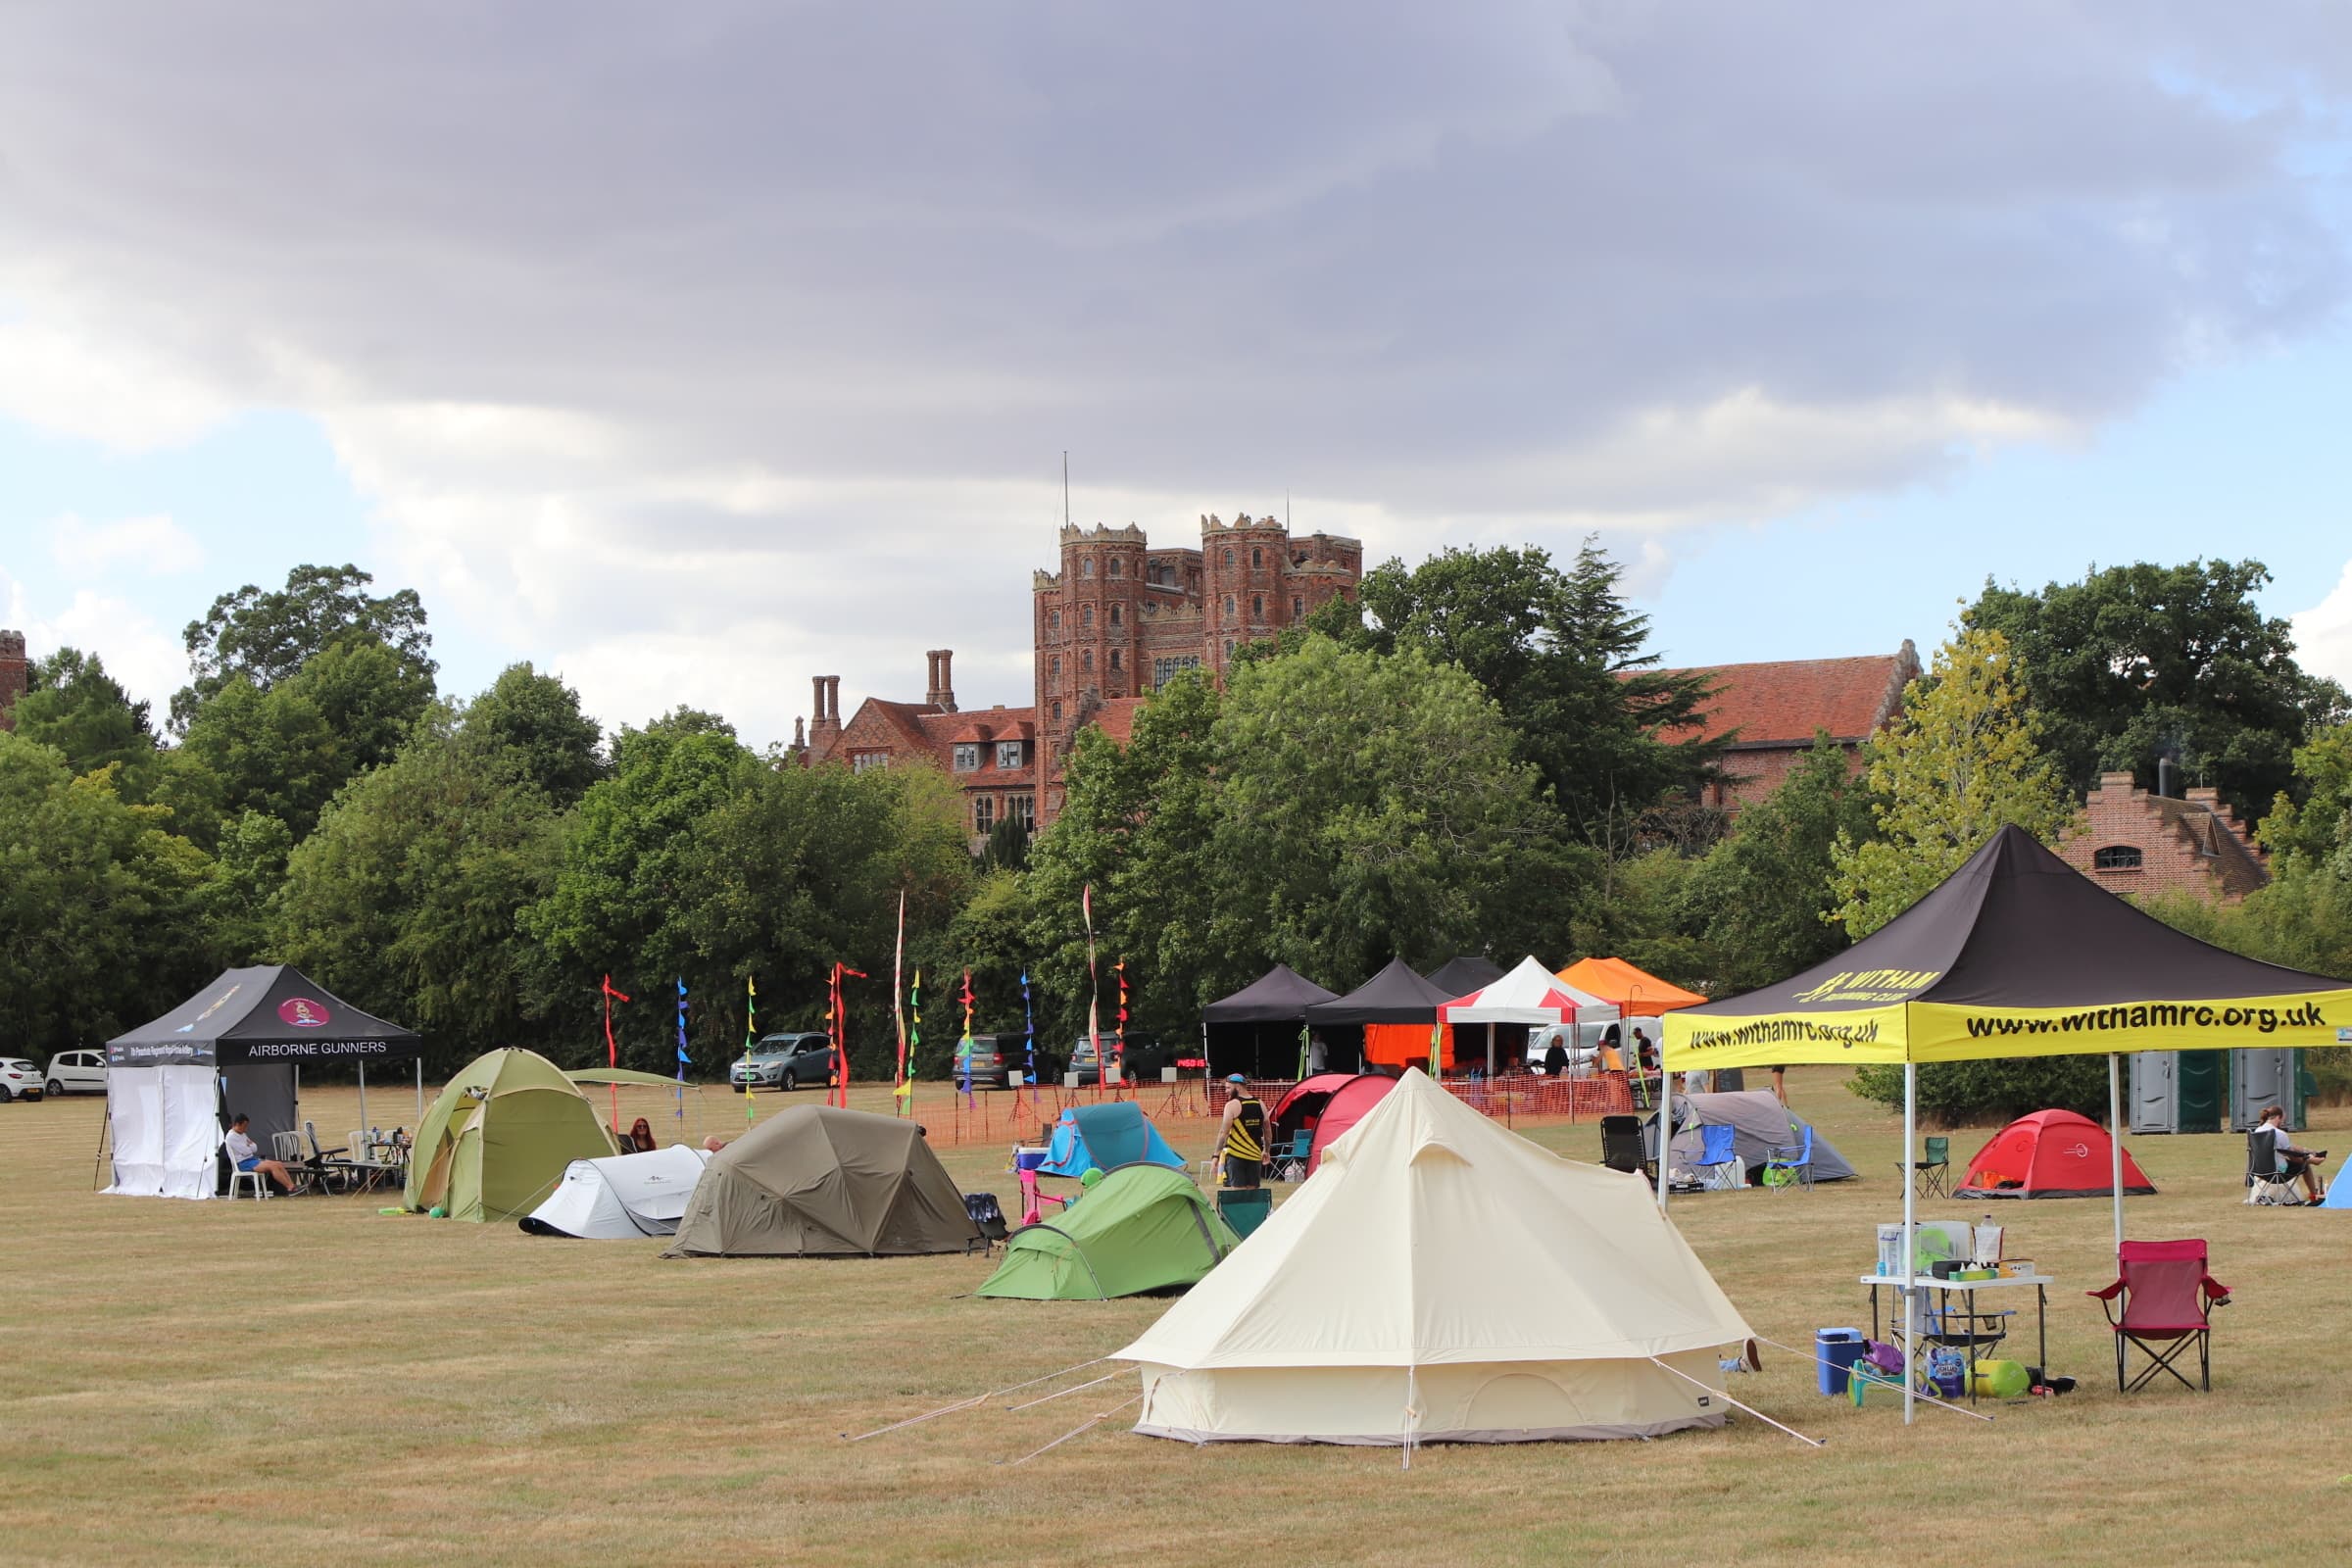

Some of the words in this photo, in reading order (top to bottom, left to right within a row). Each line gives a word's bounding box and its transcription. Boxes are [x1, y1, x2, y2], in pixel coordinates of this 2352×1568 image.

[1842, 968, 1941, 989] WITHAM
[1689, 1017, 1880, 1050] www.withamrc.org.uk
[1966, 1001, 2327, 1039] www.withamrc.org.uk
[248, 1042, 318, 1057] AIRBORNE
[320, 1041, 387, 1054] GUNNERS
